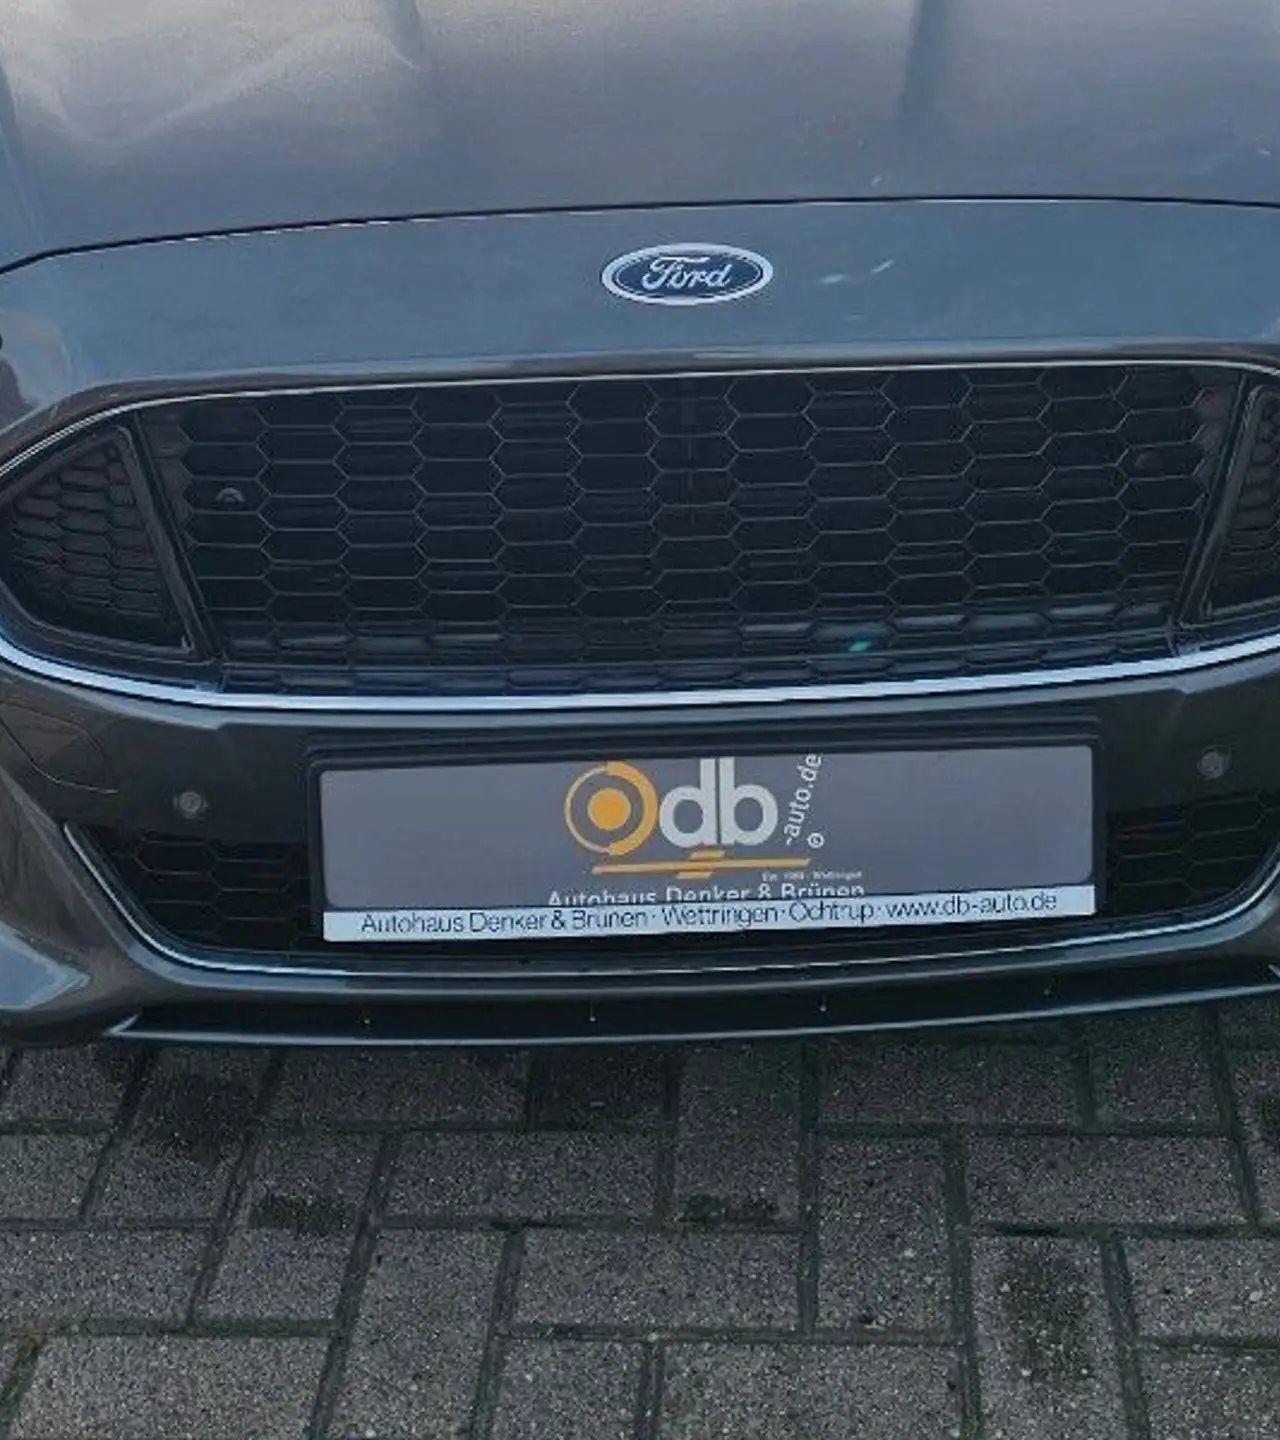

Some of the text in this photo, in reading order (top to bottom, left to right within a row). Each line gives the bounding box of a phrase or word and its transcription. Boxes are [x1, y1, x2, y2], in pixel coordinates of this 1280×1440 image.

[641, 255, 734, 291] Ford
[659, 756, 778, 848] db
[361, 911, 465, 933] Autohaus
[551, 909, 567, 931] &
[662, 901, 779, 928] Wettringen
